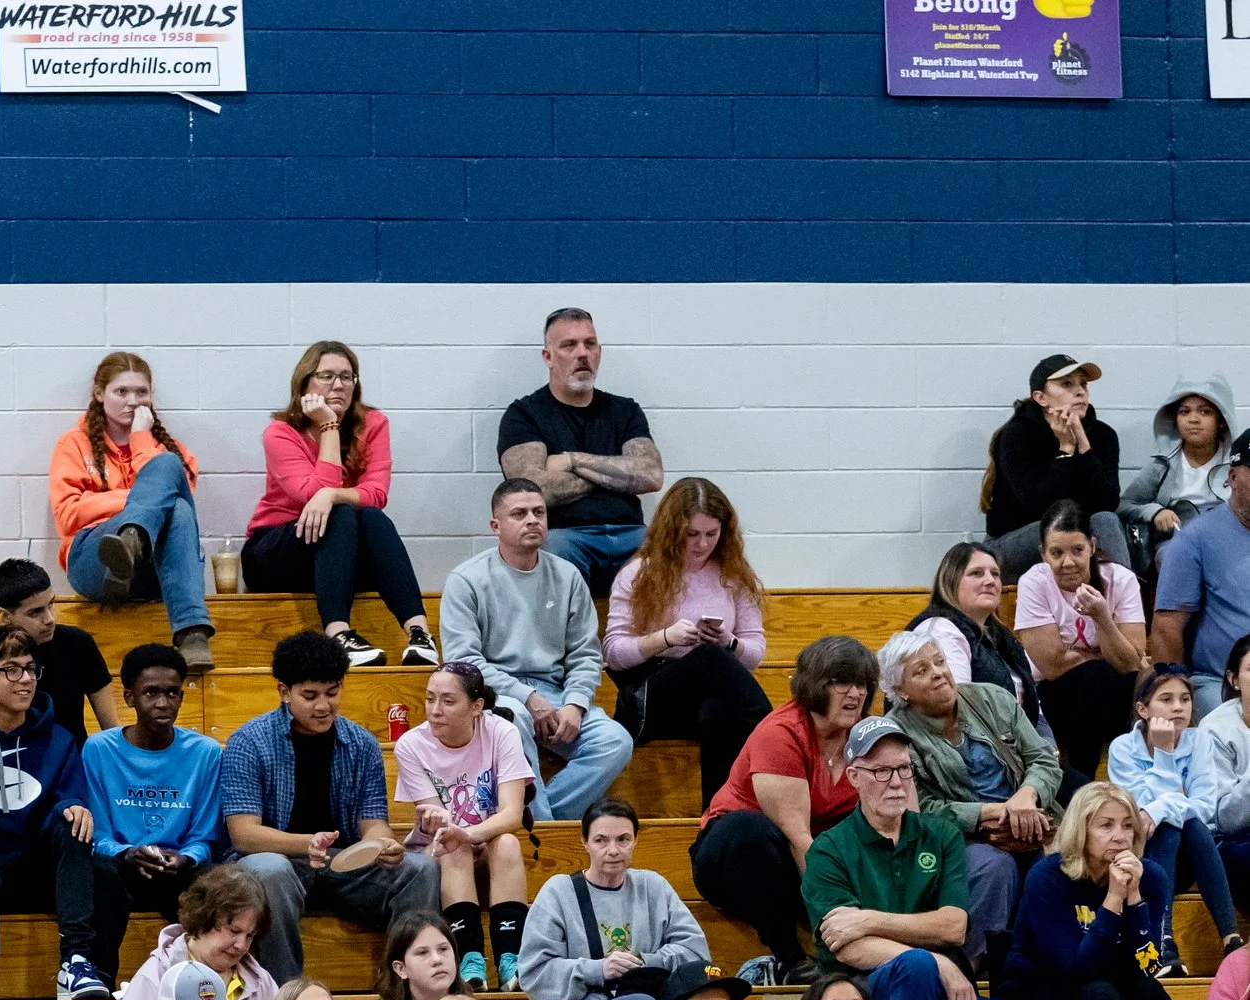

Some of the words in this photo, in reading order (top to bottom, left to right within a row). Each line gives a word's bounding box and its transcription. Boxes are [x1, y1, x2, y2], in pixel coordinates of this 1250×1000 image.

[0, 3, 155, 29] WATERFORD
[156, 2, 237, 31] HILLS
[44, 33, 75, 42] road
[78, 33, 119, 44] racing
[123, 33, 157, 42] since
[162, 32, 193, 42] 1958
[31, 57, 212, 78] Waterfordhills.com
[913, 57, 942, 66] Planet
[944, 57, 977, 67] Fitness
[977, 58, 1023, 67] Waterford
[1052, 61, 1081, 69] planet
[900, 69, 920, 78] 5142
[921, 69, 960, 80] Highland
[962, 70, 977, 80] Rd,
[977, 70, 1019, 79] Waterford
[1020, 71, 1039, 81] Twp
[1056, 67, 1088, 76] fitness
[127, 788, 180, 800] MOTT
[115, 798, 192, 809] VOLLEYBALL
